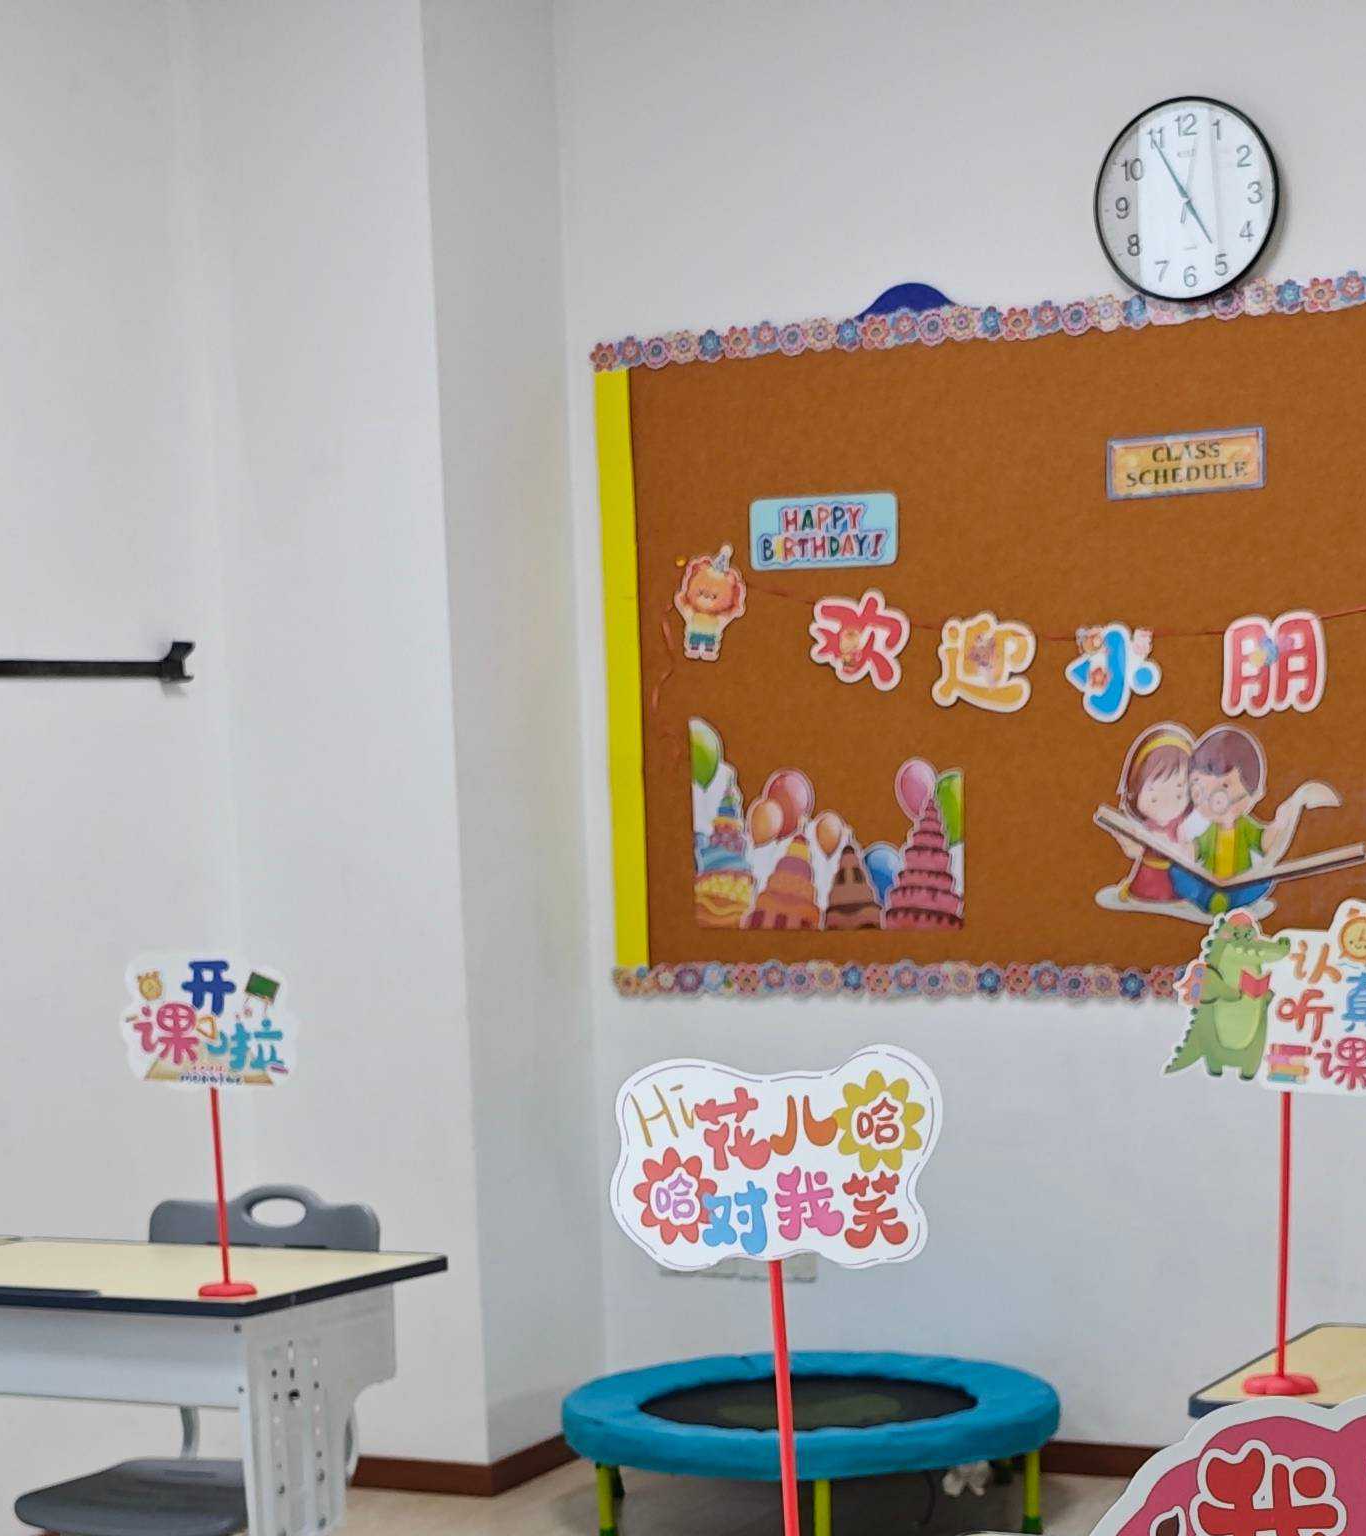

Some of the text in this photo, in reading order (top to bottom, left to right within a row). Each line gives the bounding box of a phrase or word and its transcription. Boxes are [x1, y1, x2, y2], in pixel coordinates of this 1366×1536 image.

[1174, 113, 1198, 137] 12
[1212, 118, 1222, 141] 1
[1147, 127, 1166, 149] 11
[1236, 144, 1252, 168] 2
[1121, 157, 1144, 182] 10
[1247, 180, 1263, 204] 3
[1115, 196, 1130, 219] 9
[1239, 220, 1255, 242] 4
[1127, 233, 1141, 257] 8
[1154, 259, 1170, 283] 7
[1184, 265, 1198, 288] 6
[1214, 253, 1229, 276] 5
[1151, 441, 1222, 464] CLASS
[1126, 461, 1249, 488] SCHEDULE
[783, 506, 863, 531] HAPPY
[761, 533, 886, 562] BIRTHDAY!
